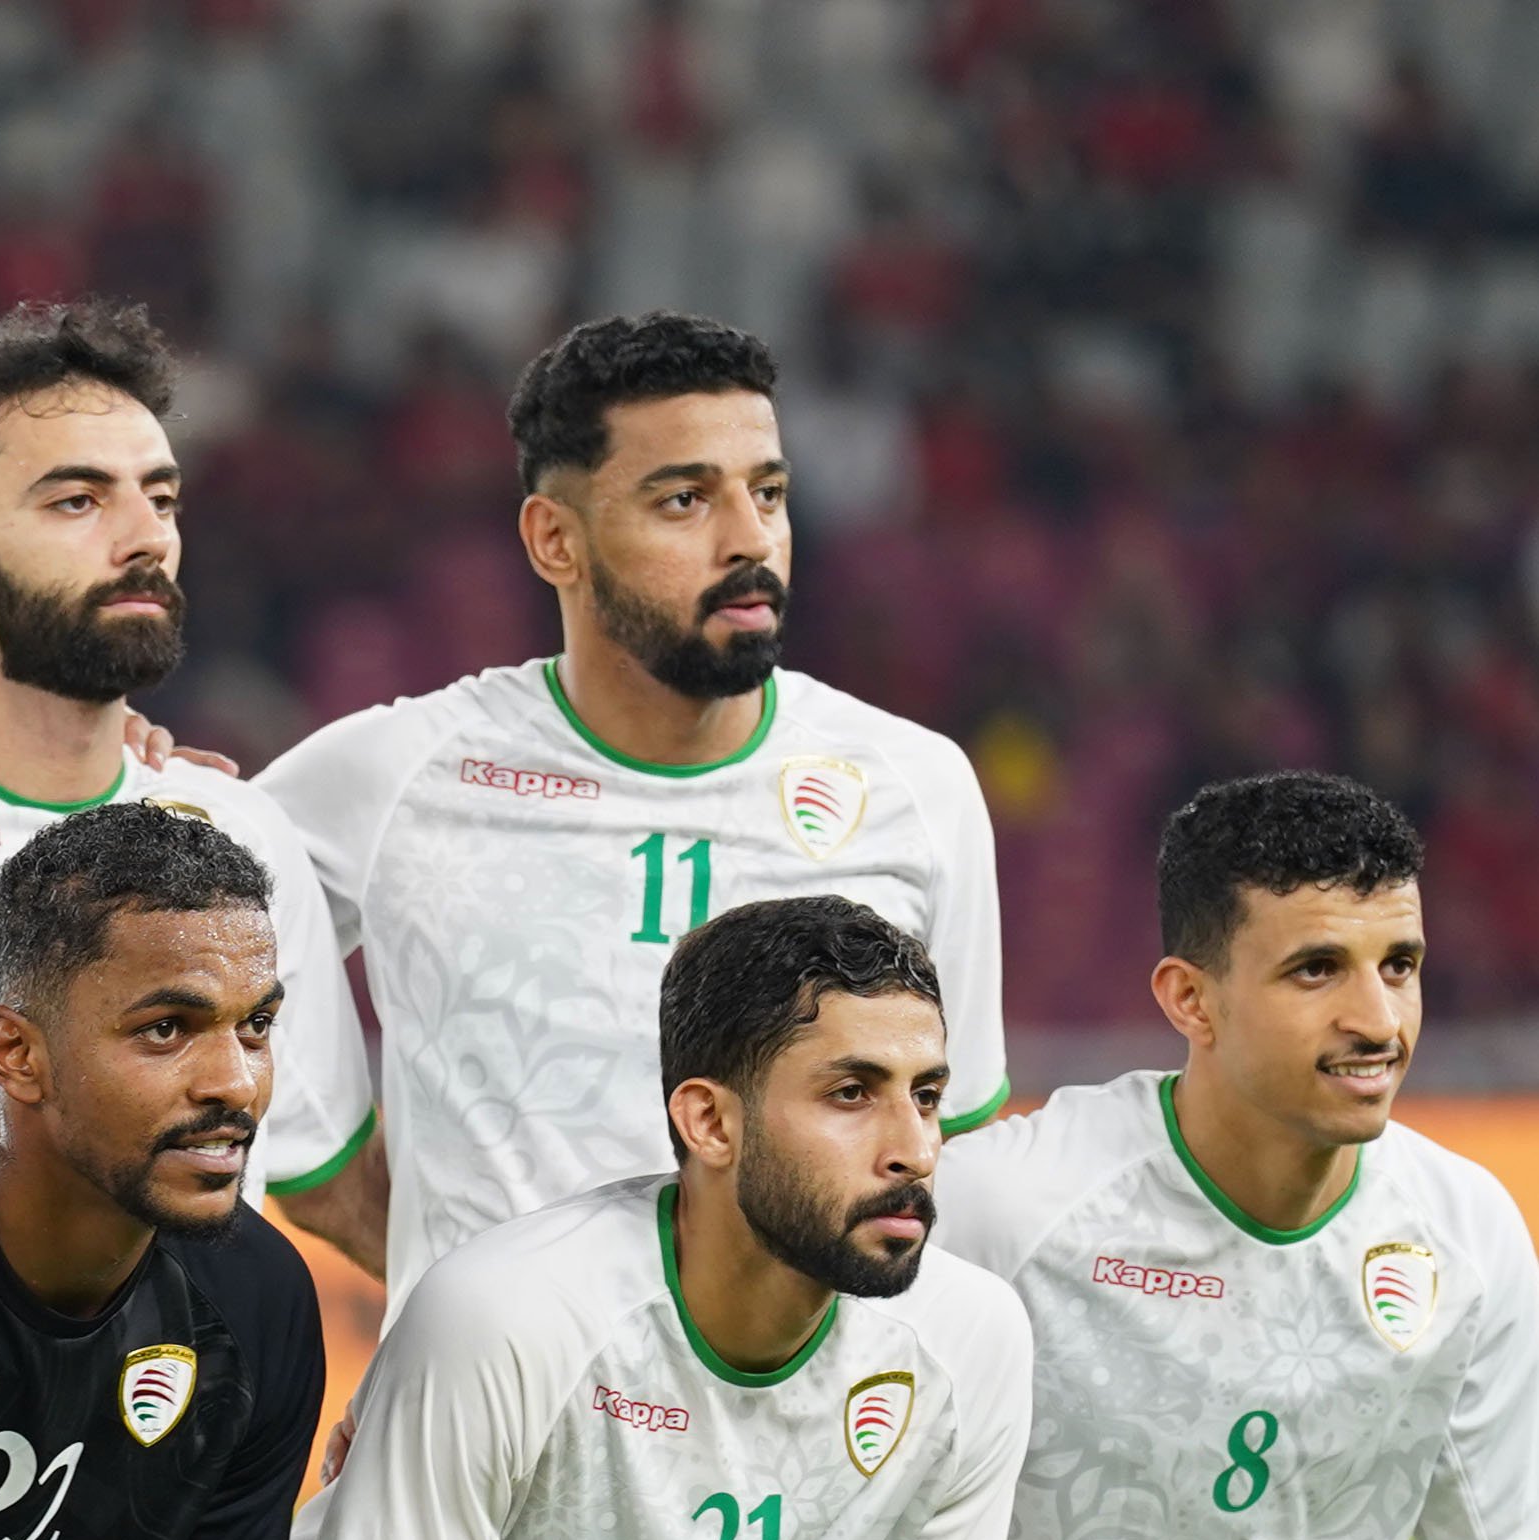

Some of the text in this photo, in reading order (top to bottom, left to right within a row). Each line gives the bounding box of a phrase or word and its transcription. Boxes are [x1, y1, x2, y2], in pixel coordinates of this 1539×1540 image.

[459, 756, 602, 801] Kappa
[630, 832, 712, 944] 11
[1092, 1255, 1225, 1300] Kappa
[591, 1384, 691, 1433] Kappa
[1211, 1408, 1280, 1514] 8
